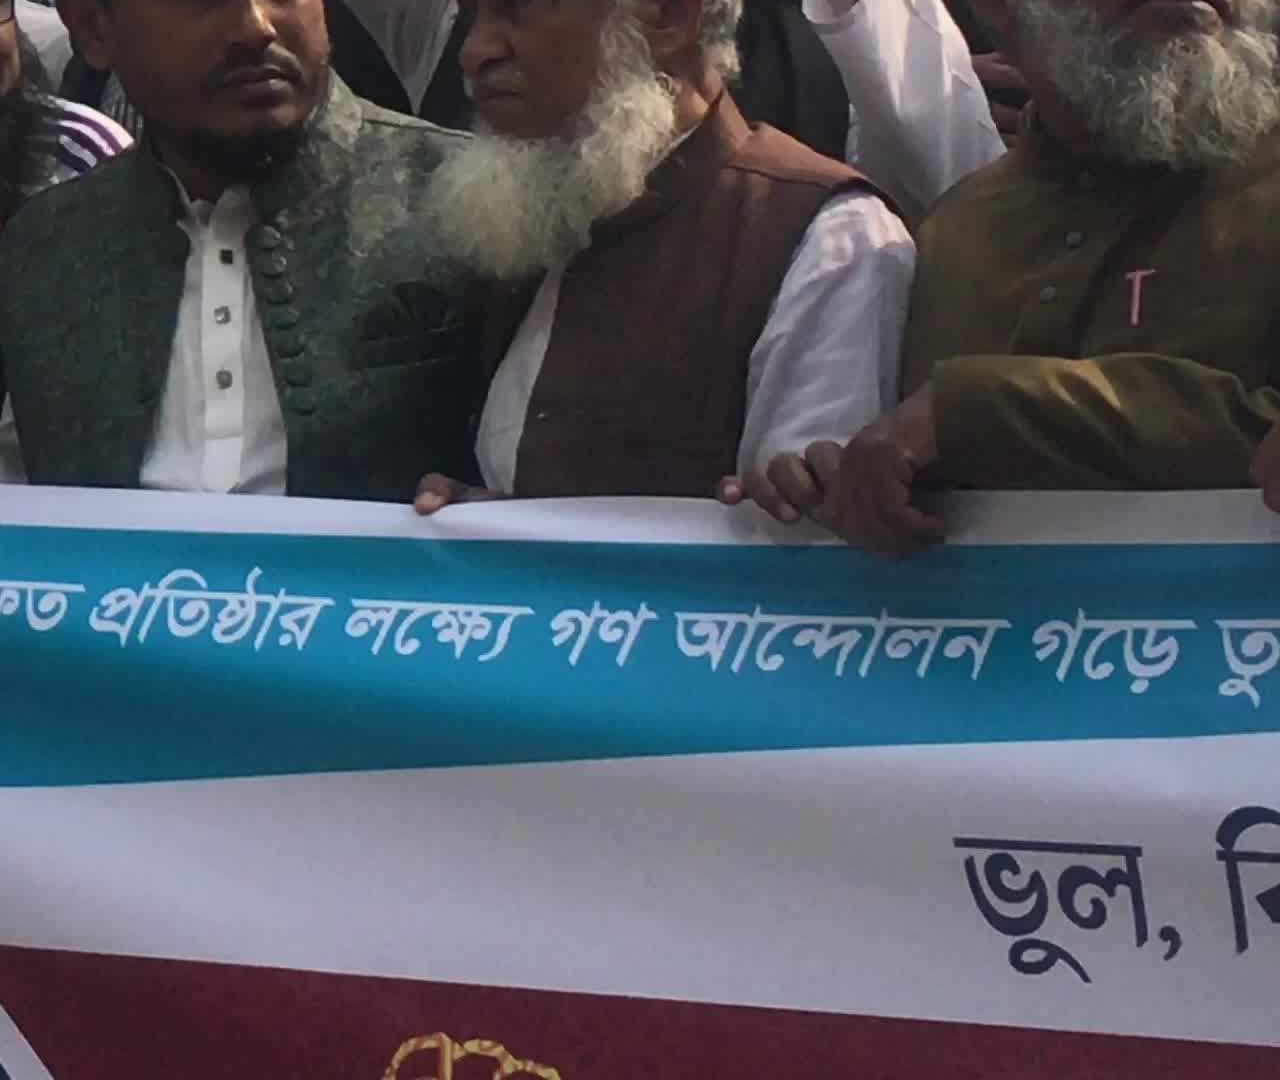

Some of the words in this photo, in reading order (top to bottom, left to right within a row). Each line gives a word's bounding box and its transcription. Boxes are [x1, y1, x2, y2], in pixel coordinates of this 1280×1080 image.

[88, 566, 335, 651] প্রতিষ্ঠার
[344, 597, 535, 663] লক্ষ্যে
[550, 600, 659, 667] গণ
[674, 605, 1012, 680] আন্দোলন
[1031, 608, 1196, 694] গড়ে
[953, 836, 1182, 984] ভুল,
